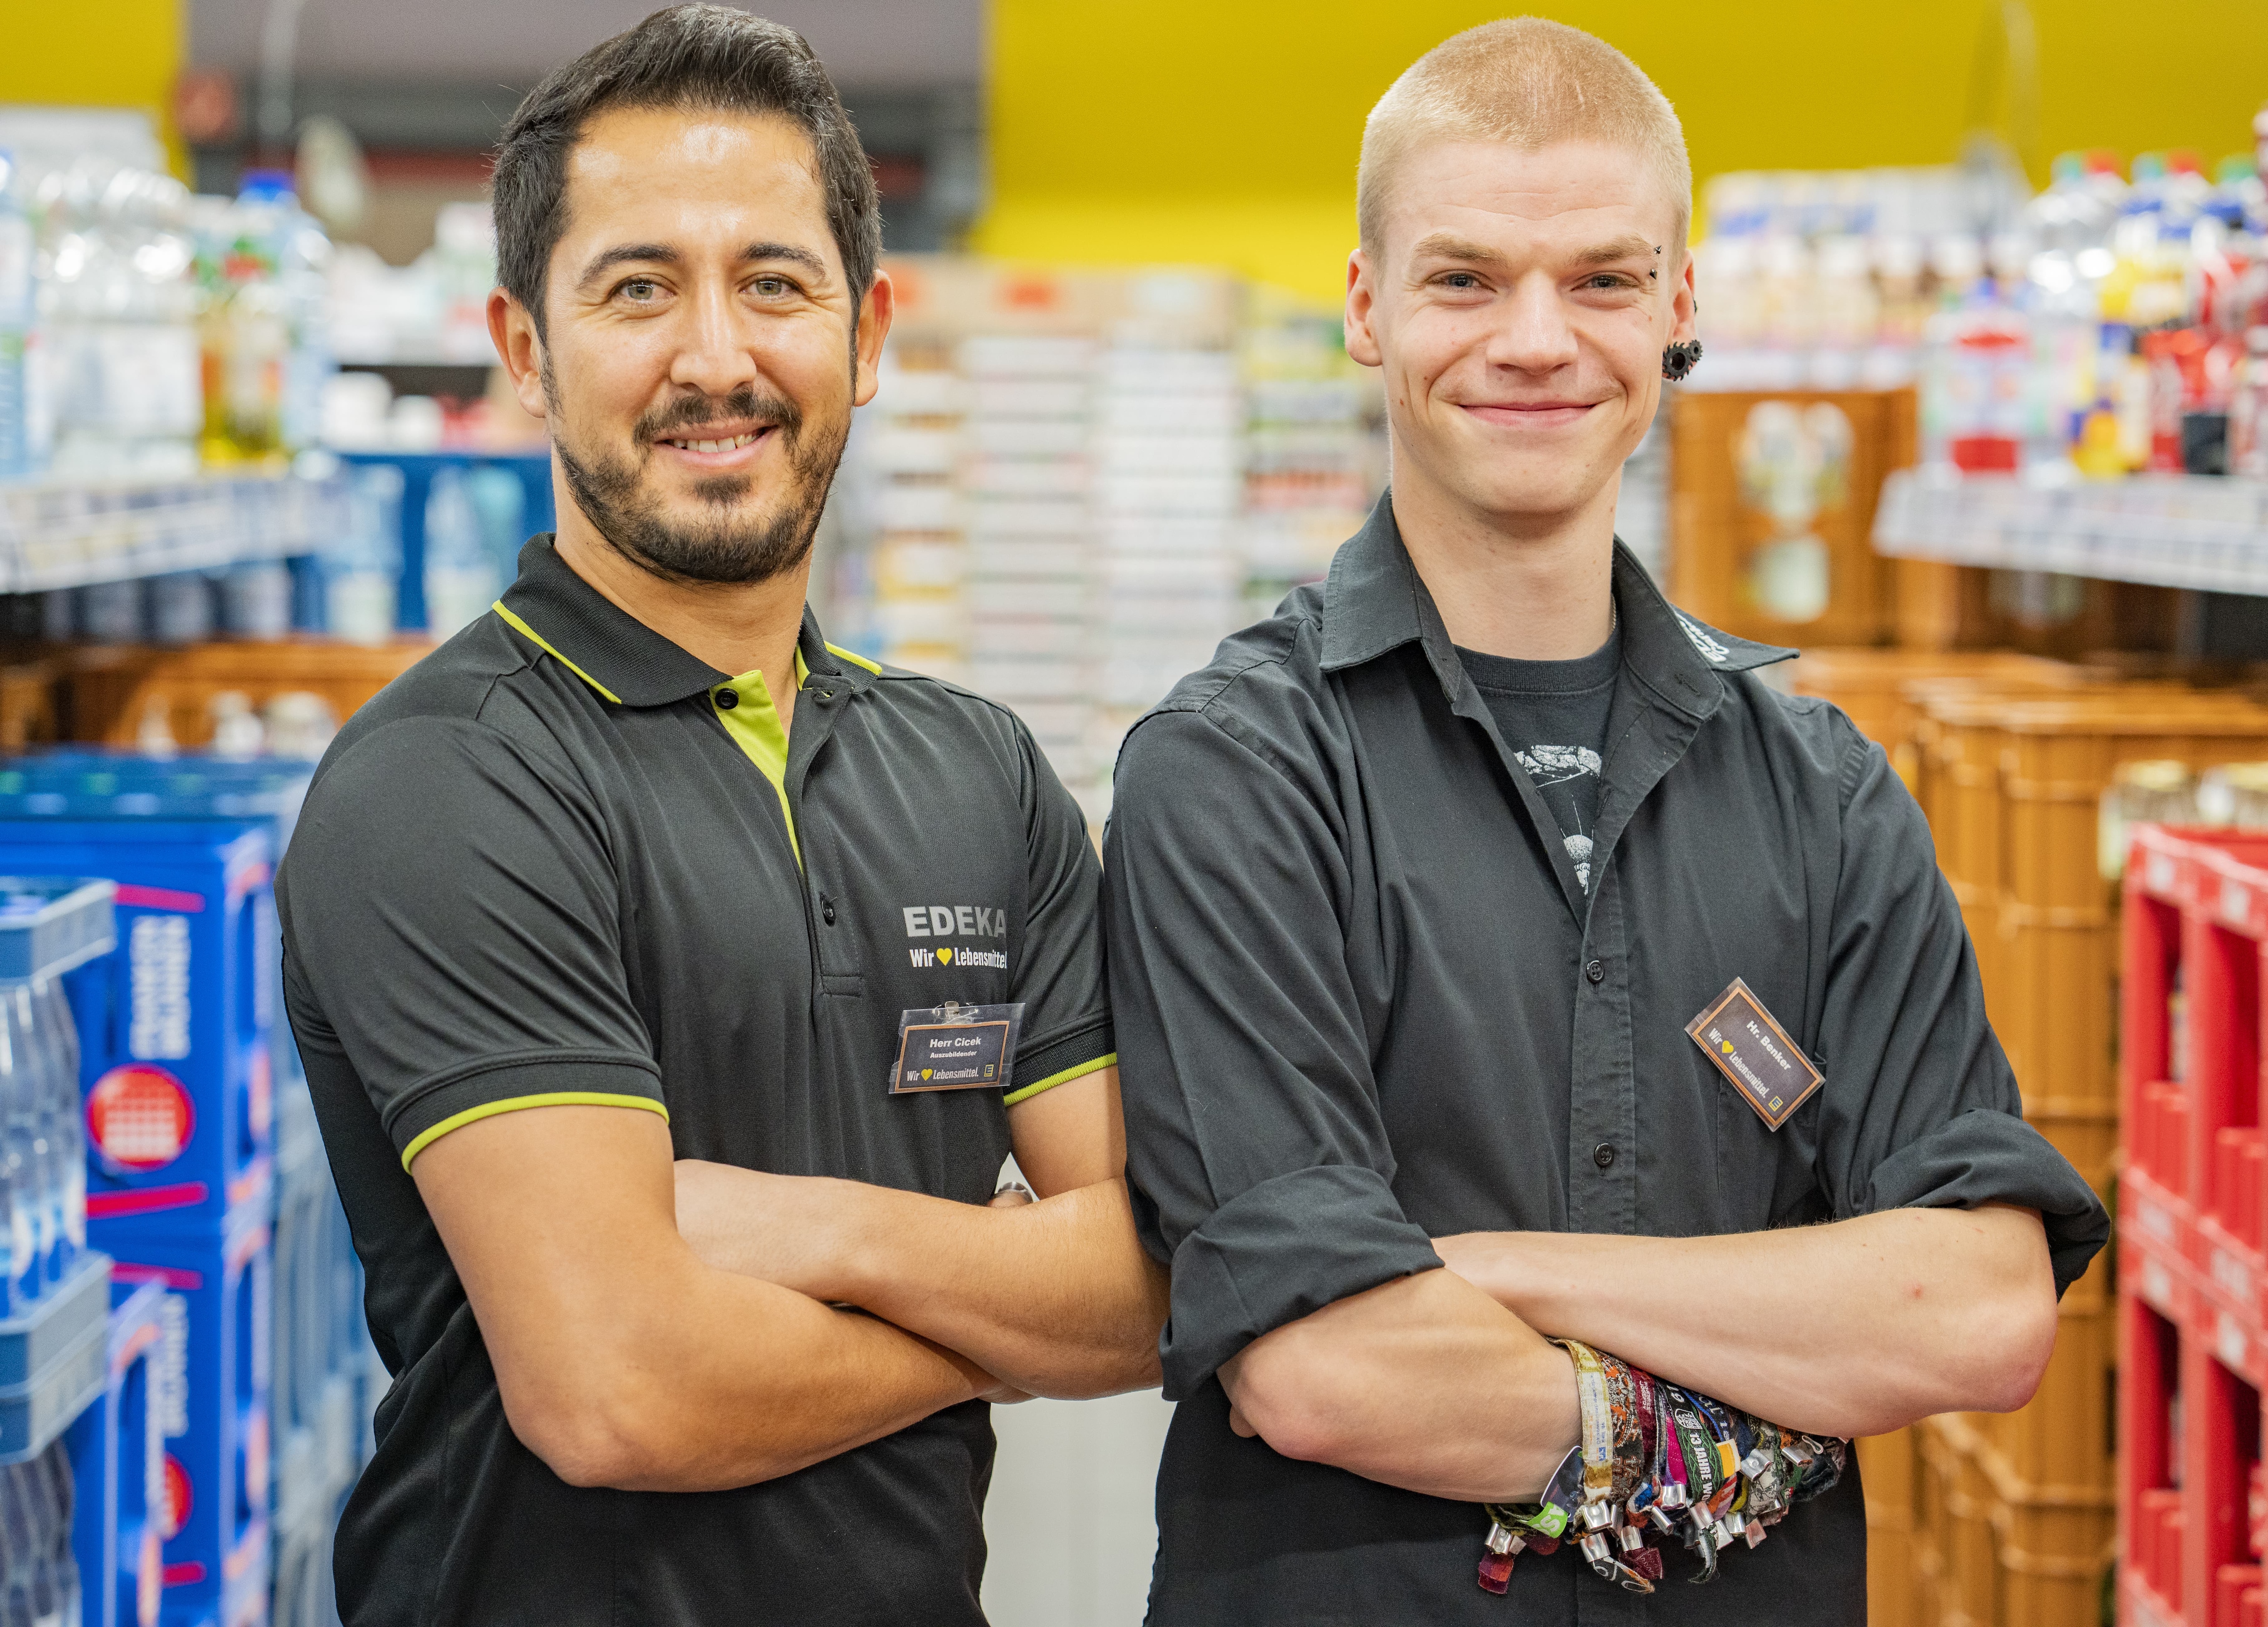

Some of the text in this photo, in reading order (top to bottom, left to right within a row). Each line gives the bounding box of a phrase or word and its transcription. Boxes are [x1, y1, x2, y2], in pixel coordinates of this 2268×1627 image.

[903, 907, 1007, 938] EDEKA
[909, 949, 934, 967] Wir
[930, 1037, 981, 1048] Herr Cicek
[1746, 1020, 1791, 1070] Hr. Benker
[930, 1050, 977, 1059] Auszubildender
[1708, 1028, 1769, 1098] Wir Lebensmittel.
[907, 1067, 979, 1081] Wir Lebensmittel.
[1690, 1432, 1701, 1445] 13
[1694, 1447, 1712, 1480] JAHRE
